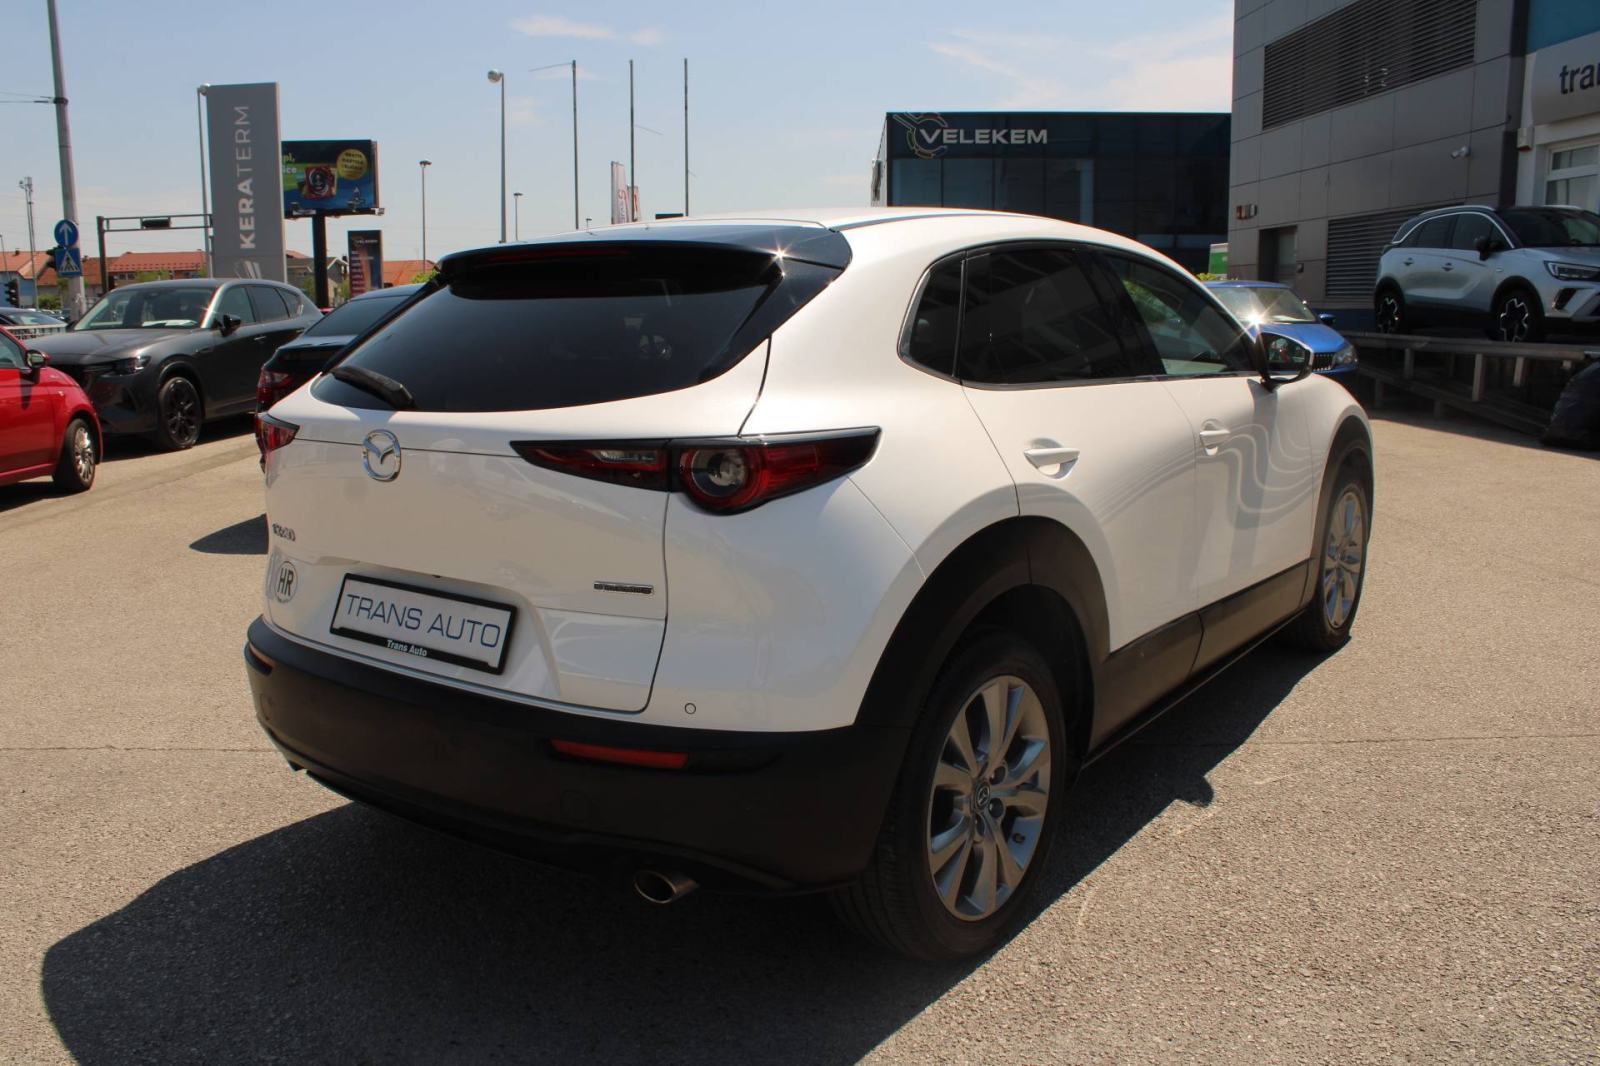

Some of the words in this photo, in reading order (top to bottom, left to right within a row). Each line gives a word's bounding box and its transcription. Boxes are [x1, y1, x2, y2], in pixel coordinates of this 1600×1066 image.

[1559, 62, 1600, 94] tra
[920, 128, 1048, 144] VELEKEM
[234, 106, 256, 249] KERATERM
[277, 567, 294, 596] HR
[347, 594, 423, 631] TRANS
[427, 613, 501, 648] AUTO
[386, 639, 408, 653] Trans
[409, 644, 428, 657] Auto
